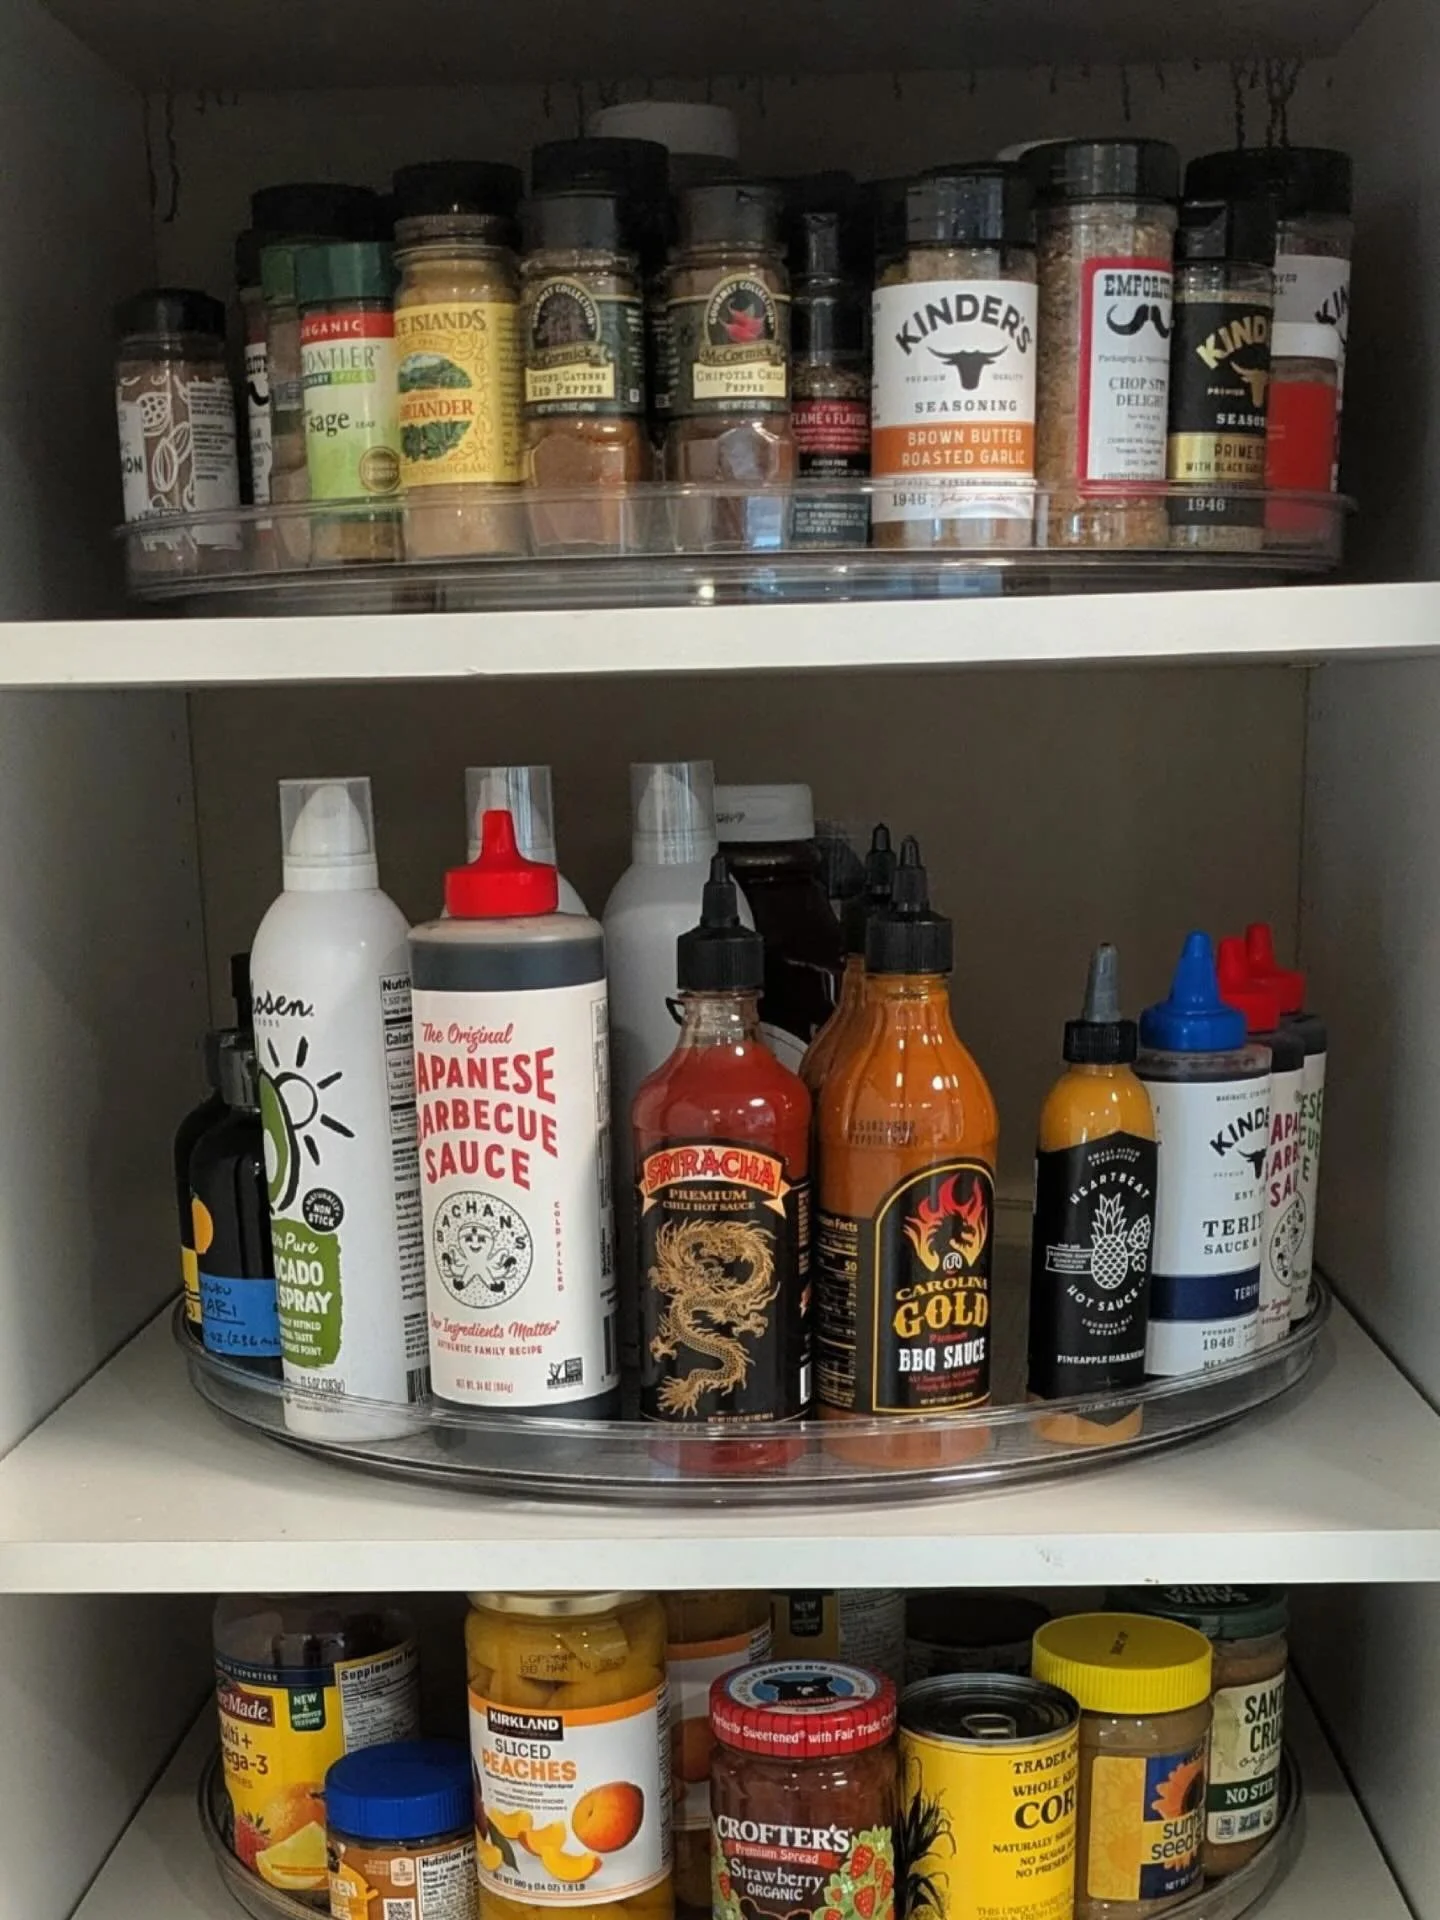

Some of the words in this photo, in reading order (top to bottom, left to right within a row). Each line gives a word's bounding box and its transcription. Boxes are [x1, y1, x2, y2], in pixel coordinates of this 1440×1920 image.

[411, 308, 487, 333] ISLANDS
[895, 293, 1033, 356] KINDER'S
[1109, 377, 1146, 390] CHOP
[914, 399, 1018, 414] SEASONING
[309, 412, 350, 437] sage
[908, 430, 964, 447] BROWN
[970, 428, 1022, 444] BUTTER
[902, 450, 974, 467] ROASTED
[979, 449, 1025, 465] GARLIC
[1186, 498, 1226, 513] 1946
[422, 1022, 444, 1043] The
[448, 1022, 514, 1053] Original
[416, 1047, 556, 1105] APANESE
[425, 1141, 530, 1191] SAUCE
[647, 1148, 775, 1191] SRIRACHA
[669, 1188, 748, 1201] PREMIUM
[1070, 1172, 1151, 1205] HEARTBEAT
[313, 1203, 331, 1215] NON
[663, 1201, 691, 1210] CHILI
[694, 1202, 717, 1211] HOT
[720, 1201, 757, 1212] SAUCE
[308, 1213, 334, 1228] STICK
[436, 1200, 527, 1250] BACHAN'S
[284, 1231, 319, 1254] Pure
[1204, 1238, 1249, 1255] SAUCE
[279, 1286, 333, 1314] SPRAY
[1067, 1284, 1095, 1309] HOT
[1097, 1288, 1139, 1312] SAUCE
[893, 1291, 989, 1339] GOLD
[443, 1317, 504, 1341] Ingredients
[508, 1320, 558, 1342] Matter
[474, 1345, 505, 1356] FAMILY
[509, 1345, 543, 1356] RECIPE
[898, 1348, 936, 1372] BBQ
[943, 1337, 985, 1370] SAUCE
[1203, 1336, 1235, 1351] 1946
[1057, 1355, 1107, 1364] PINEAPPLE
[751, 1663, 827, 1677] CROFTER'S
[293, 1692, 318, 1706] NEW
[490, 1709, 559, 1732] KIRKLAND
[808, 1730, 832, 1743] with
[834, 1727, 855, 1741] Fair
[856, 1722, 881, 1737] Trade
[495, 1738, 551, 1760] SLICED
[224, 1747, 269, 1775] ega-3
[482, 1748, 577, 1783] PEACHES
[1012, 1778, 1063, 1798] WHOLE
[1226, 1786, 1249, 1804] NO
[717, 1815, 850, 1853] CROFTER'S
[992, 1835, 1053, 1854] NATURALLY
[735, 1843, 777, 1859] Premium
[780, 1849, 819, 1865] Spread
[1020, 1855, 1036, 1867] NO
[1039, 1844, 1065, 1863] SUGAR
[1151, 1833, 1193, 1861] seed
[422, 1850, 462, 1868] Nutrition
[731, 1858, 824, 1896] Strawberry
[1015, 1868, 1033, 1879] NO
[747, 1882, 804, 1901] ORGANIC
